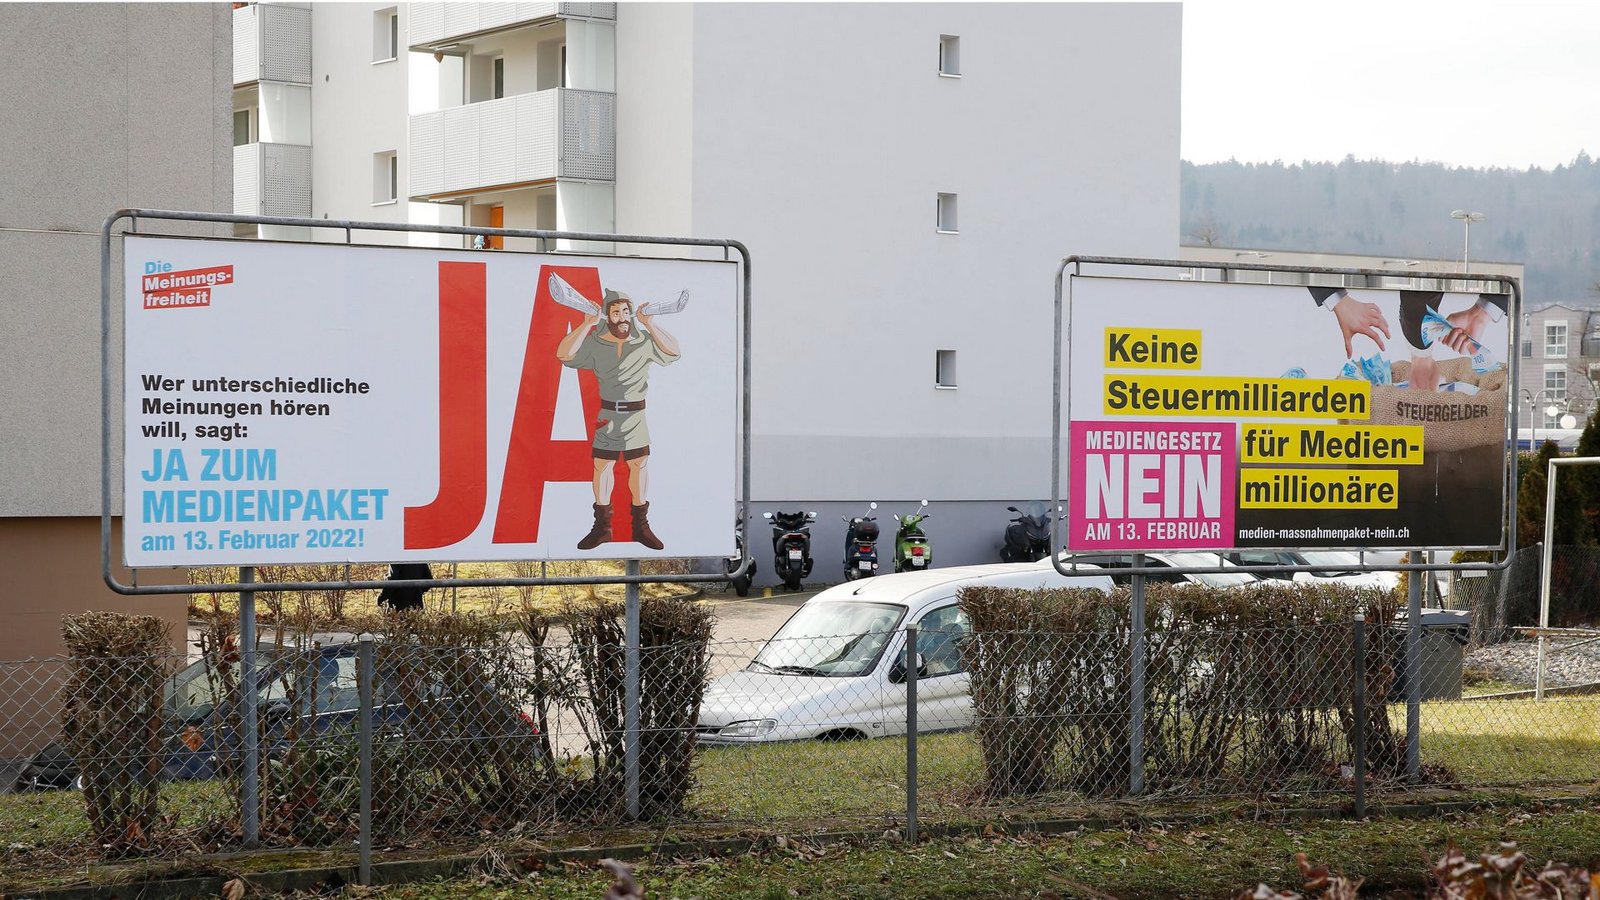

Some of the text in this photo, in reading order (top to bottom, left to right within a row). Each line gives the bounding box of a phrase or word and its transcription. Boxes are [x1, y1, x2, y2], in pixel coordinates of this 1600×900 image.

[144, 261, 172, 274] Die
[144, 271, 232, 291] Meinungs-
[145, 291, 208, 306] freiheit
[1109, 333, 1198, 363] Keine
[142, 375, 370, 394] Wer unterschiedliche
[403, 261, 636, 550] JA
[1108, 380, 1366, 414] Steuermilliarden
[142, 399, 330, 418] Meinungen hören
[1397, 401, 1488, 422] STEUERGELDER
[142, 422, 248, 441] will, sagt:
[1086, 431, 1222, 450] MEDIENGESETZ
[1245, 429, 1419, 459] für Medien-
[141, 448, 276, 482] JA ZUM
[1085, 454, 1221, 519] NEIN
[1245, 475, 1394, 504] millionäre
[143, 489, 388, 523] MEDIENPAKET
[142, 529, 364, 551] am 13. Februar 2022!
[1085, 522, 1220, 541] AM 13. FEBRUAR
[1239, 527, 1410, 541] medien-massnahmenpaket-nein.ch
